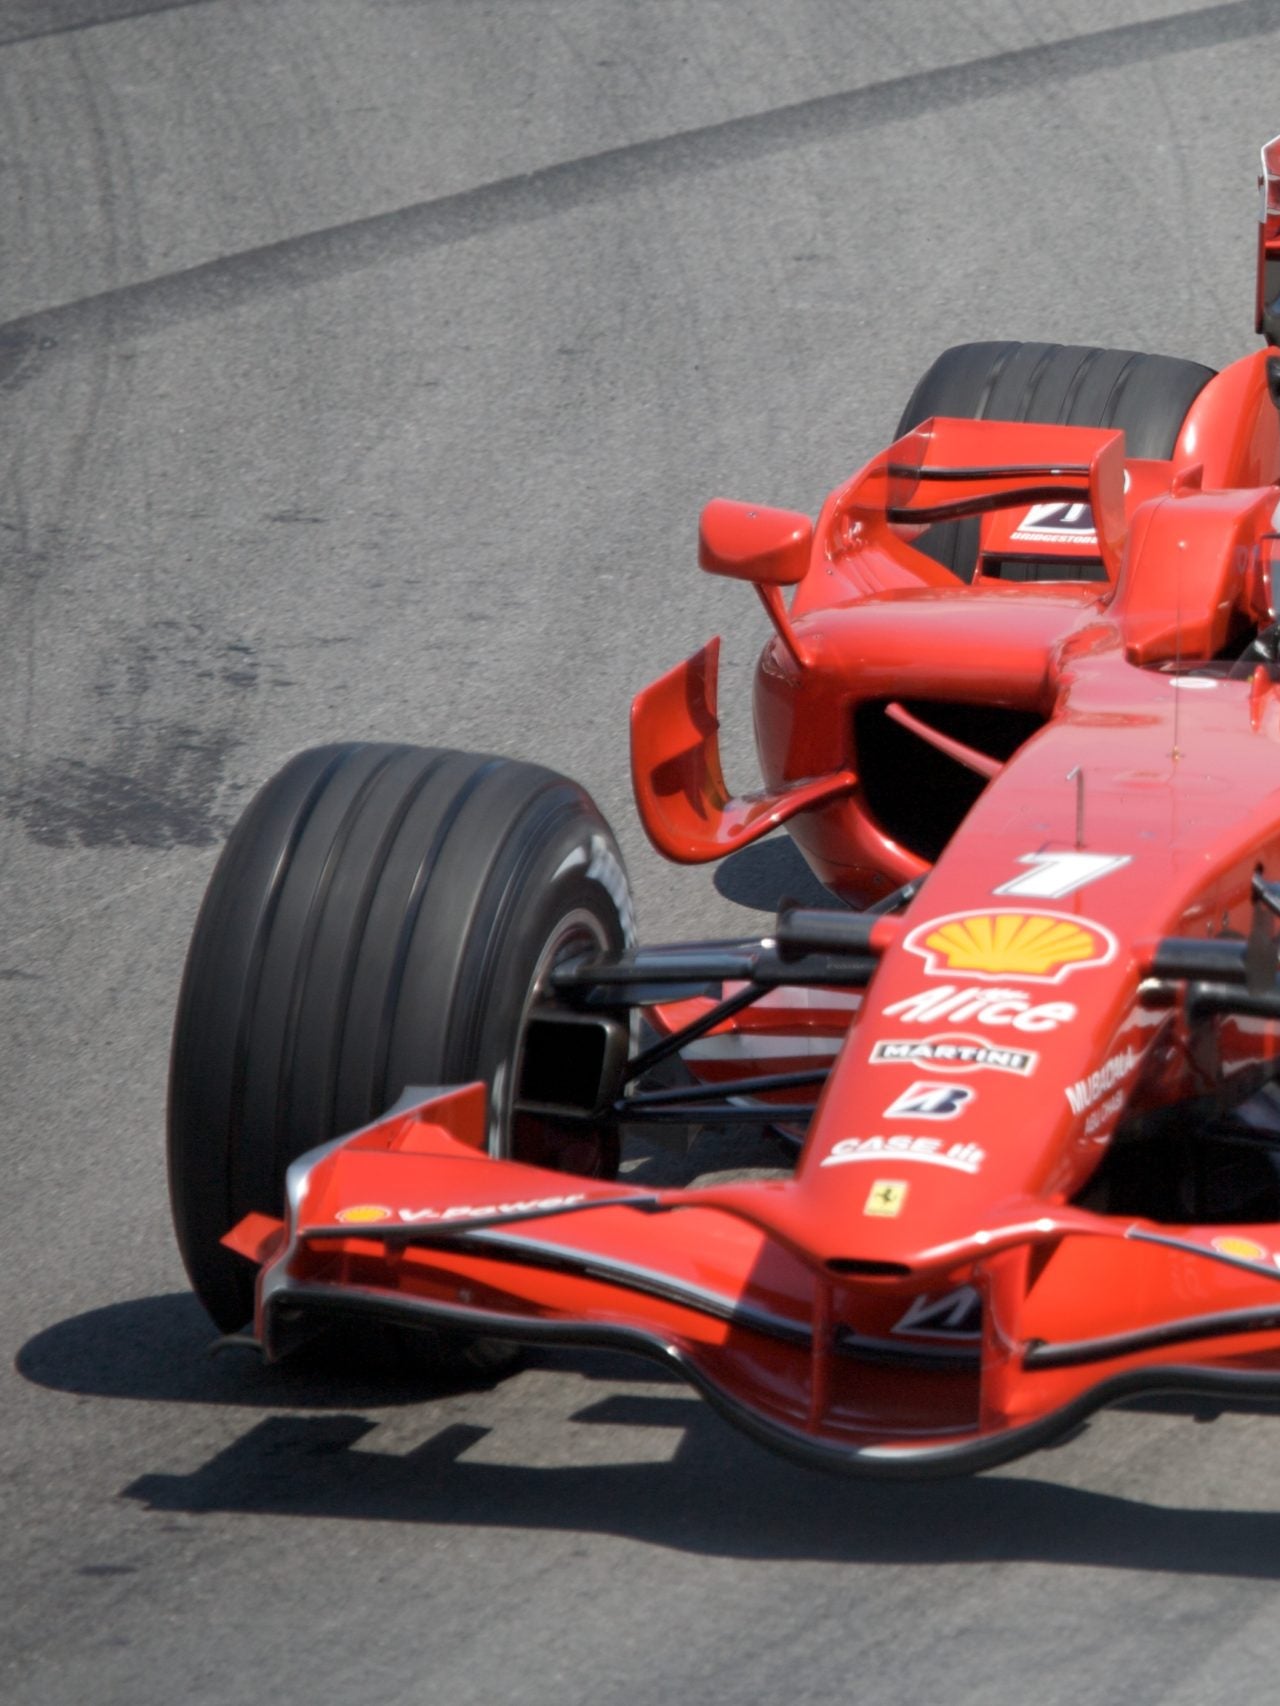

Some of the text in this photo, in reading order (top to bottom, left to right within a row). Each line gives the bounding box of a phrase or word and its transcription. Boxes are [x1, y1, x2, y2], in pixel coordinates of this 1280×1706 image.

[1009, 531, 1098, 545] BRIDGESTON
[993, 852, 1132, 898] 1
[882, 984, 1077, 1032] Alice
[882, 1044, 1025, 1067] MARTINI
[830, 1135, 943, 1156] CASE
[399, 1194, 585, 1222] V-Power
